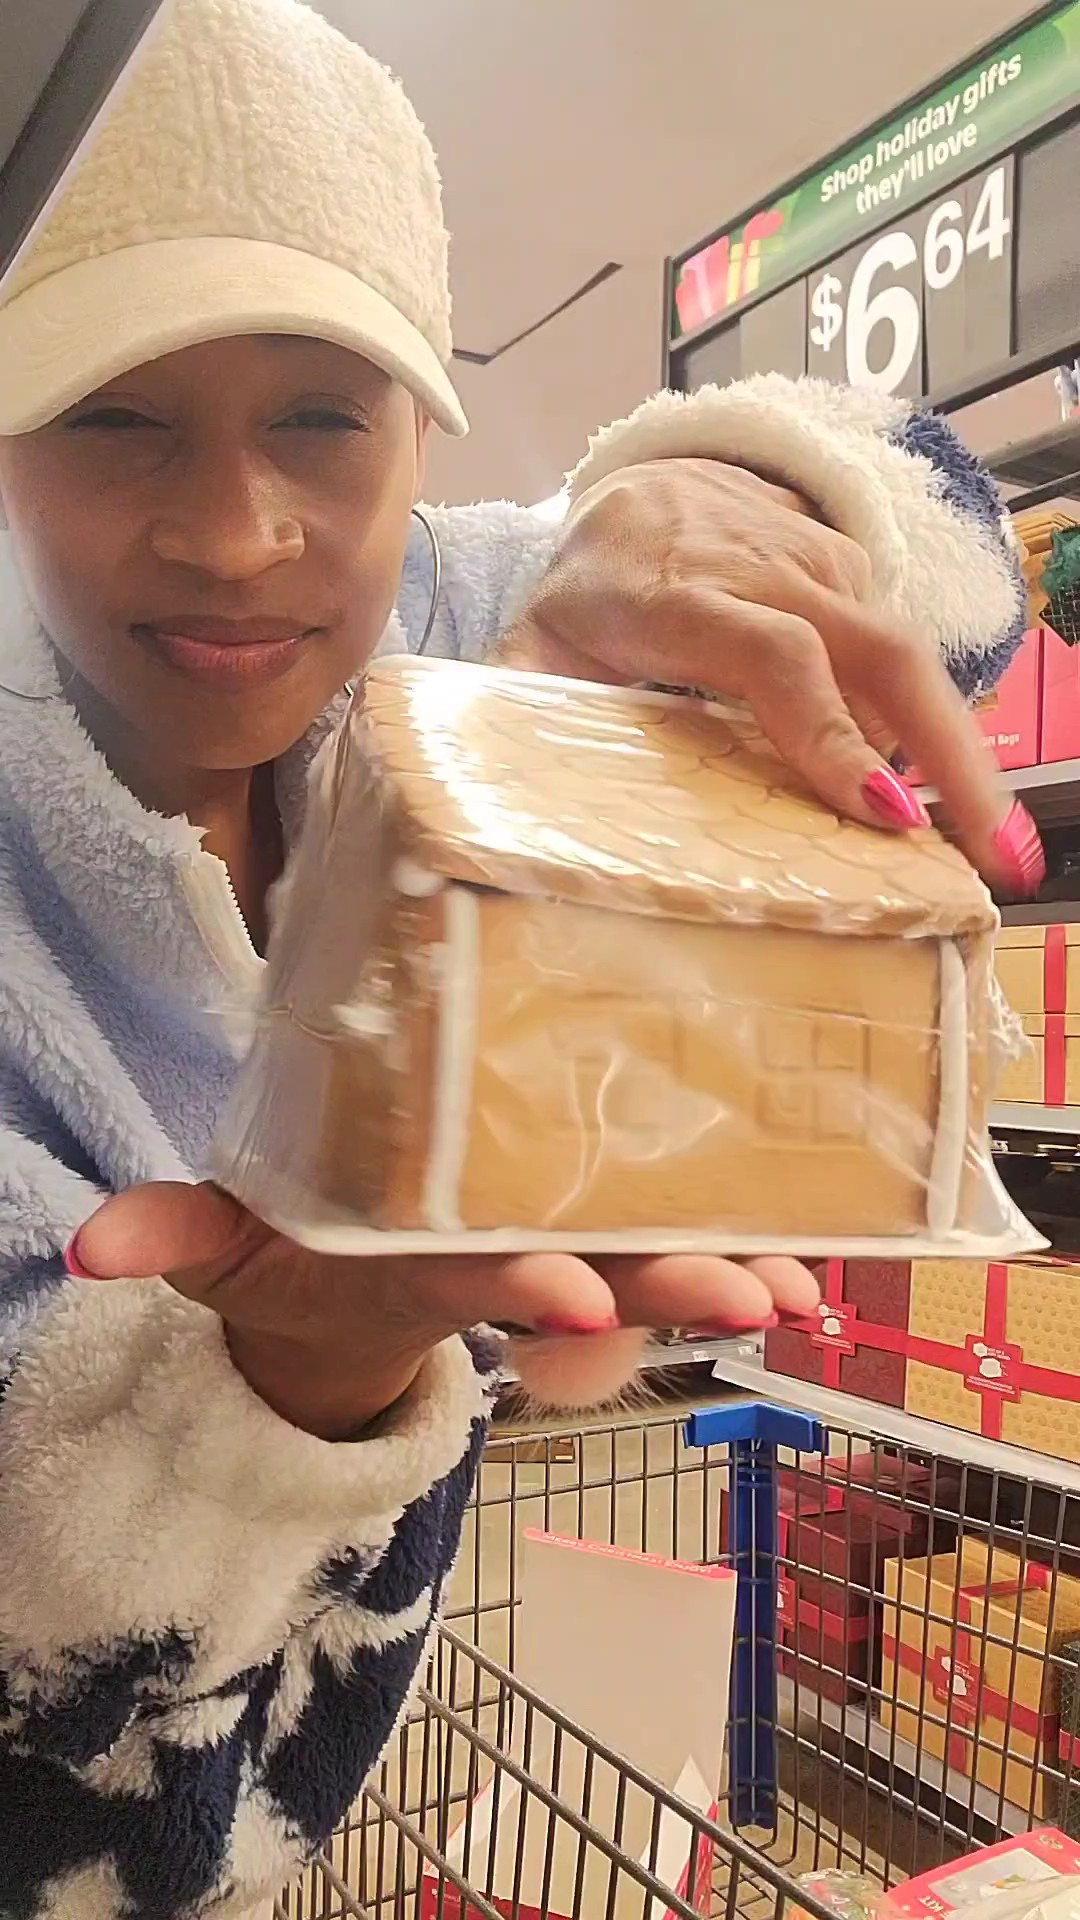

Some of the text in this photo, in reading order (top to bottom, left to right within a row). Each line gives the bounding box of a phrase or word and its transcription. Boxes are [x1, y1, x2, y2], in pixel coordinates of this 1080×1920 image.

[820, 53, 1022, 202] Shop holiday gifts
[856, 122, 978, 215] they'll love
